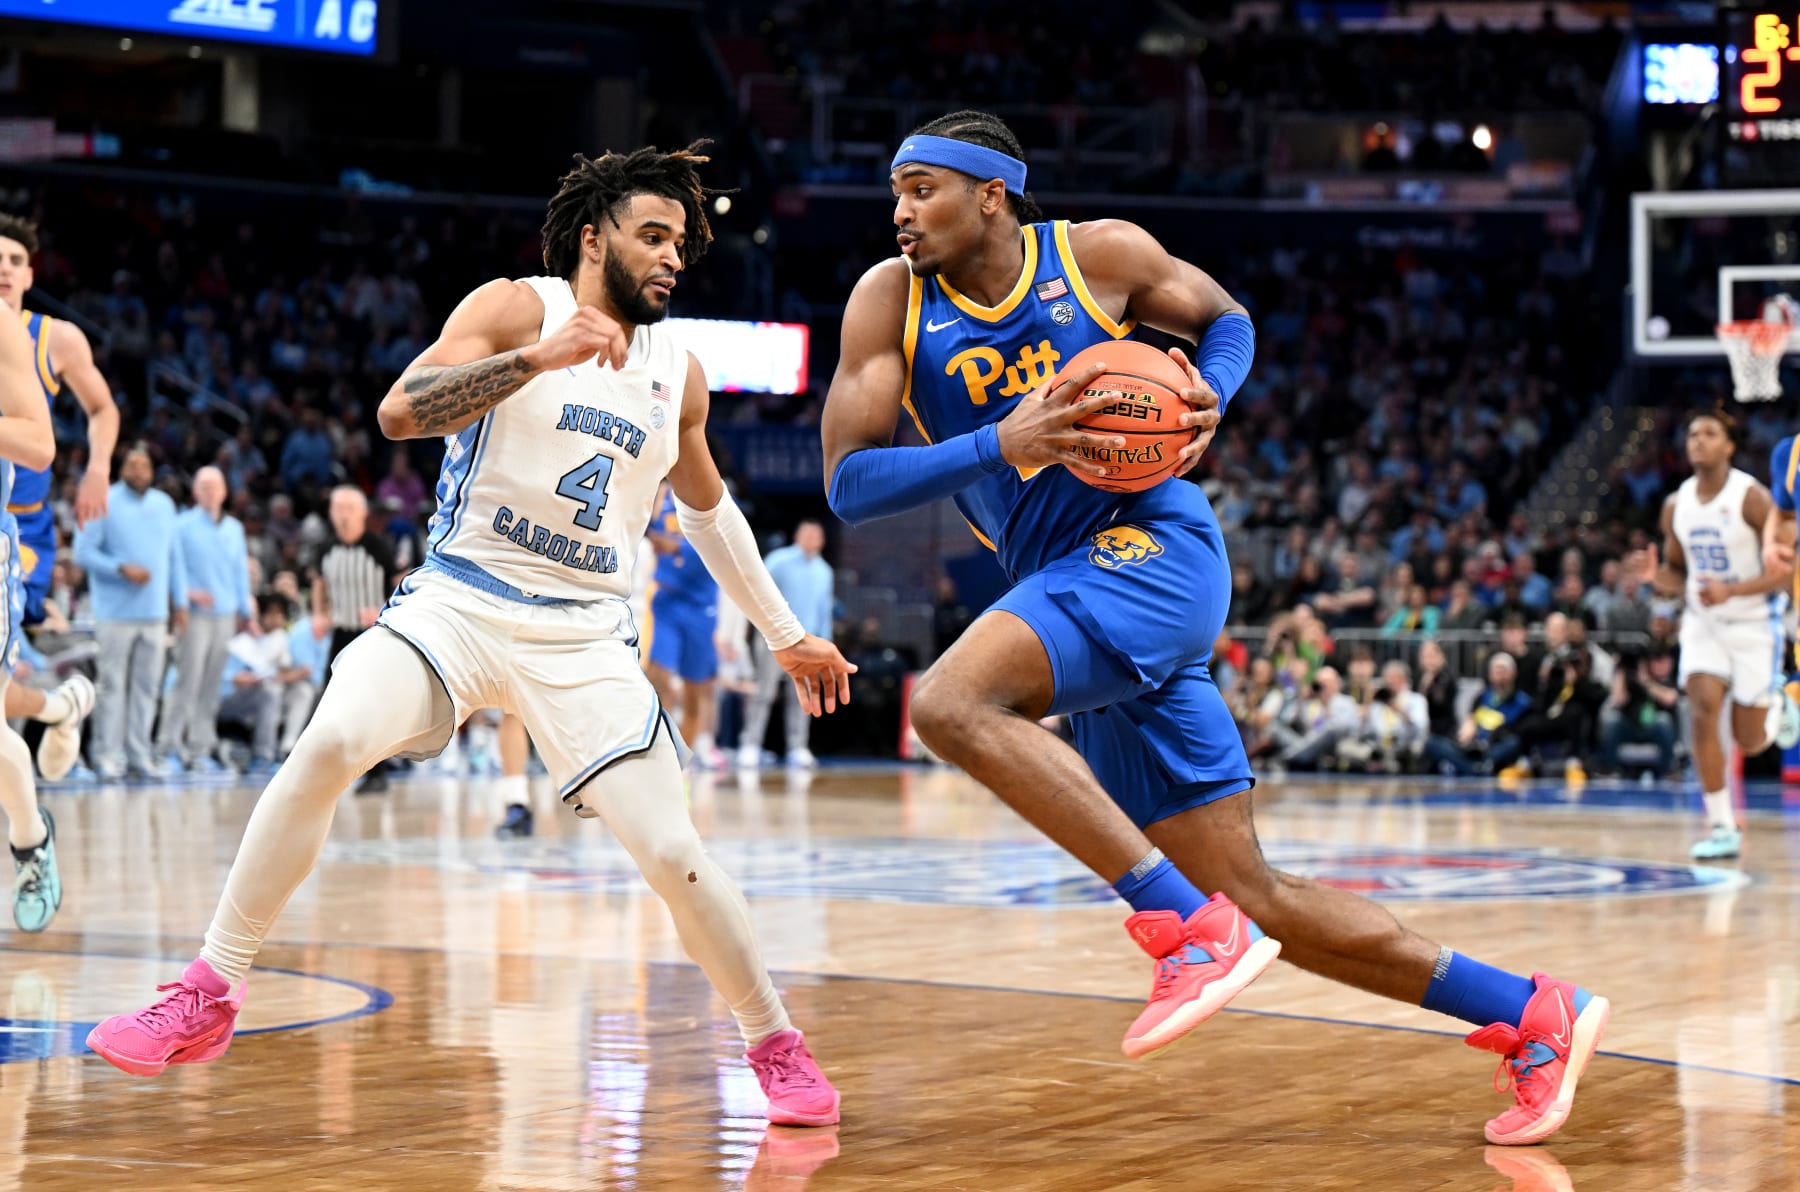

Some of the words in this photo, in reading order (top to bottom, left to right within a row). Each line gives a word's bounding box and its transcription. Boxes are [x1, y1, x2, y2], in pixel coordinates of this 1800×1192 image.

[945, 339, 1061, 406] Pitt
[556, 404, 647, 459] NORTH
[1091, 402, 1162, 423] LEGA
[555, 453, 615, 532] 4
[492, 506, 619, 574] CAROLINA
